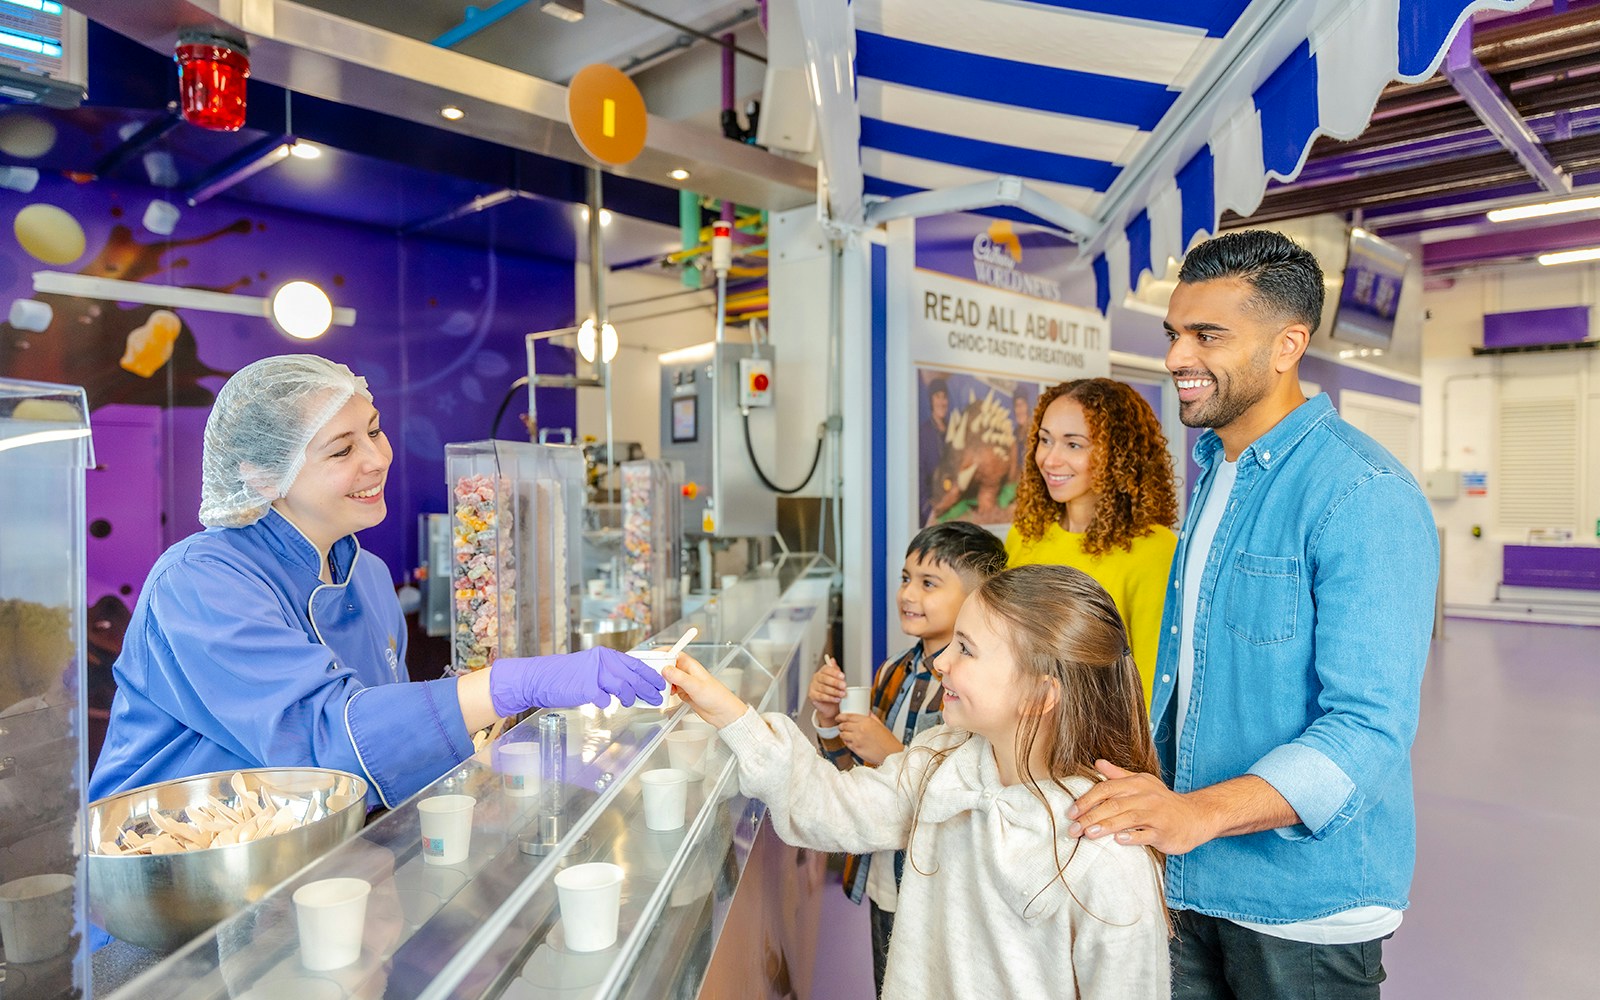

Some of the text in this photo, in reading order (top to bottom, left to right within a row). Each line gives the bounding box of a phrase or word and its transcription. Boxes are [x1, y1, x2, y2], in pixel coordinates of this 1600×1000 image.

[924, 291, 1100, 350] READ ALL ABOUT IT!
[948, 331, 1085, 368] CHOC-TASTIC CREATIONS
